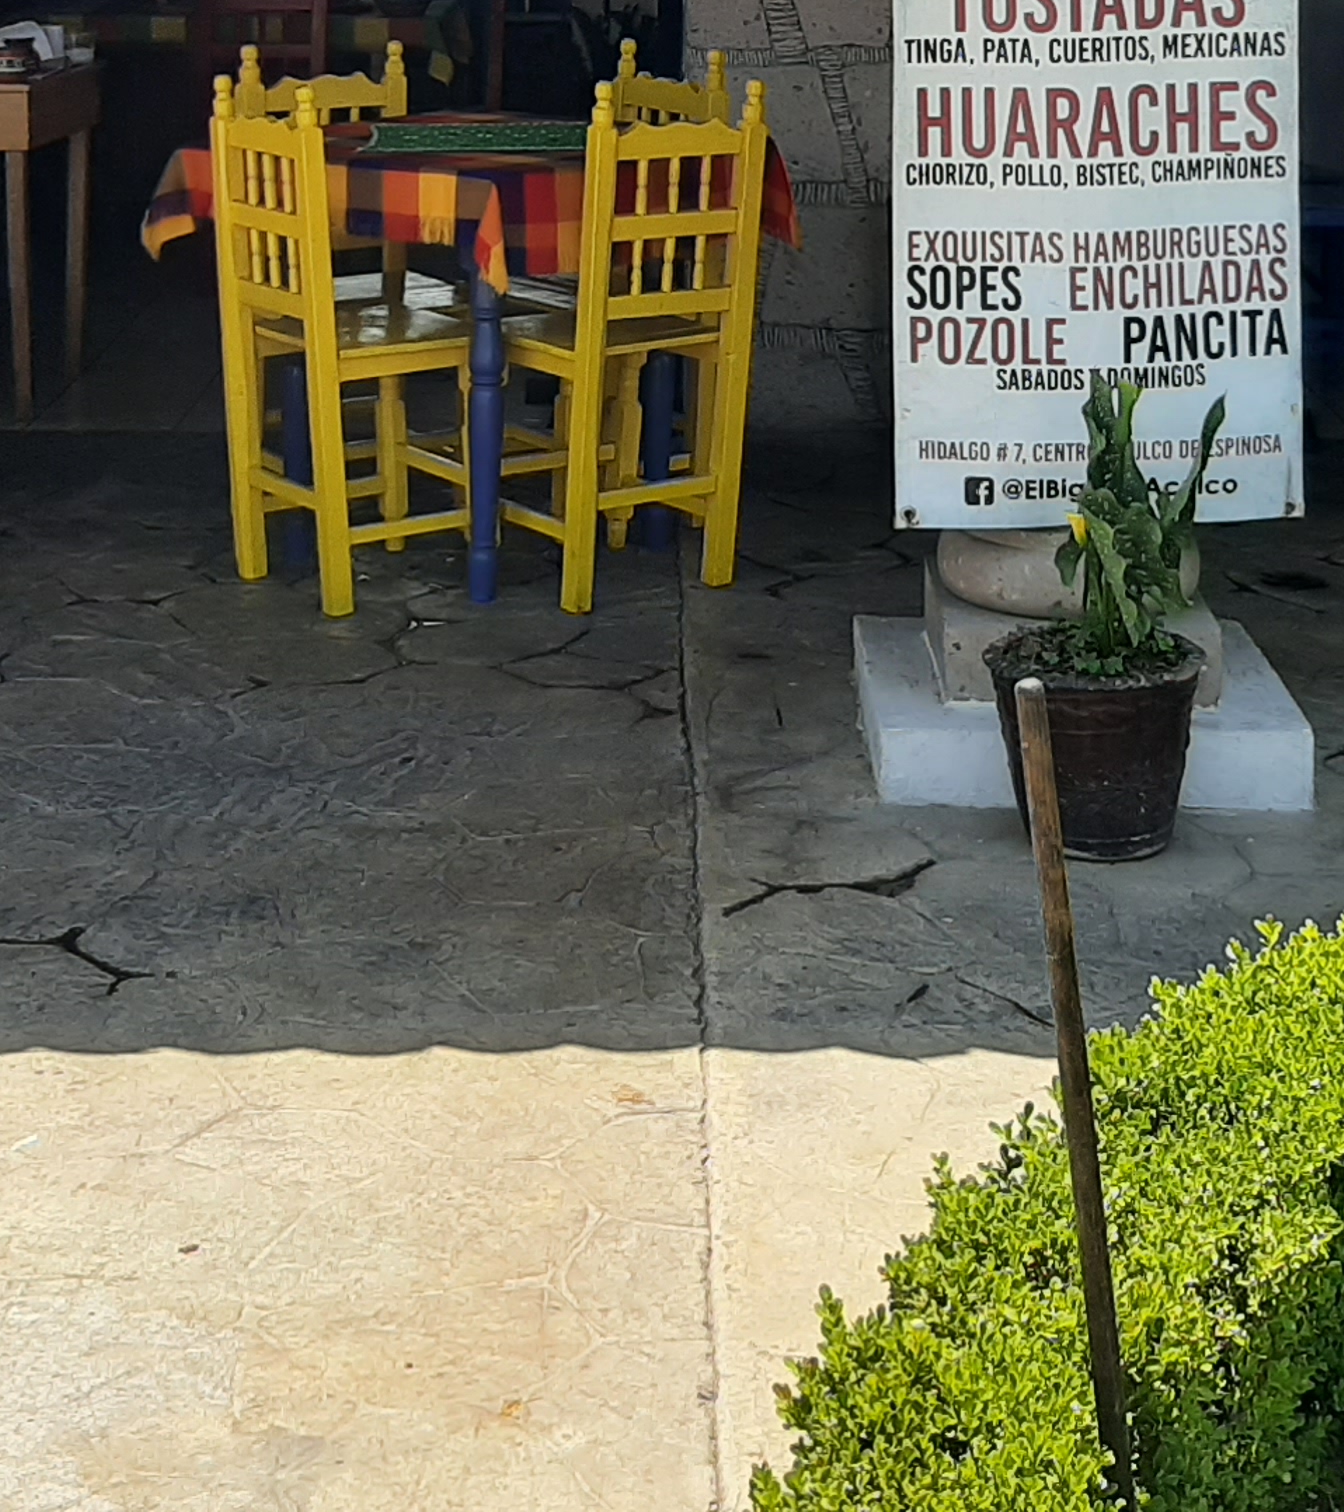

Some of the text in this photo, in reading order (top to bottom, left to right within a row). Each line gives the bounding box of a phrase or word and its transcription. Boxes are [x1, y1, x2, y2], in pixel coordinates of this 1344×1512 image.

[904, 31, 1287, 67] TINGA, PATA, CUERITOS, MEXICANAS
[915, 78, 1280, 160] HUARACHES
[905, 153, 1287, 190] CHORIZO, POLLO, BISTEC, CHAMPIÑONES
[906, 222, 1288, 264] EXQUISITAS HAMBURGUESAS
[905, 256, 1289, 313] SOPES ENCHILADAS
[908, 307, 1289, 367] POZOLE PANCITA
[995, 368, 1085, 391] SABADOS
[918, 439, 990, 462] HIDALGO
[996, 441, 1009, 463] #
[1179, 438, 1200, 460] DE
[1208, 434, 1283, 458] SPINOSA
